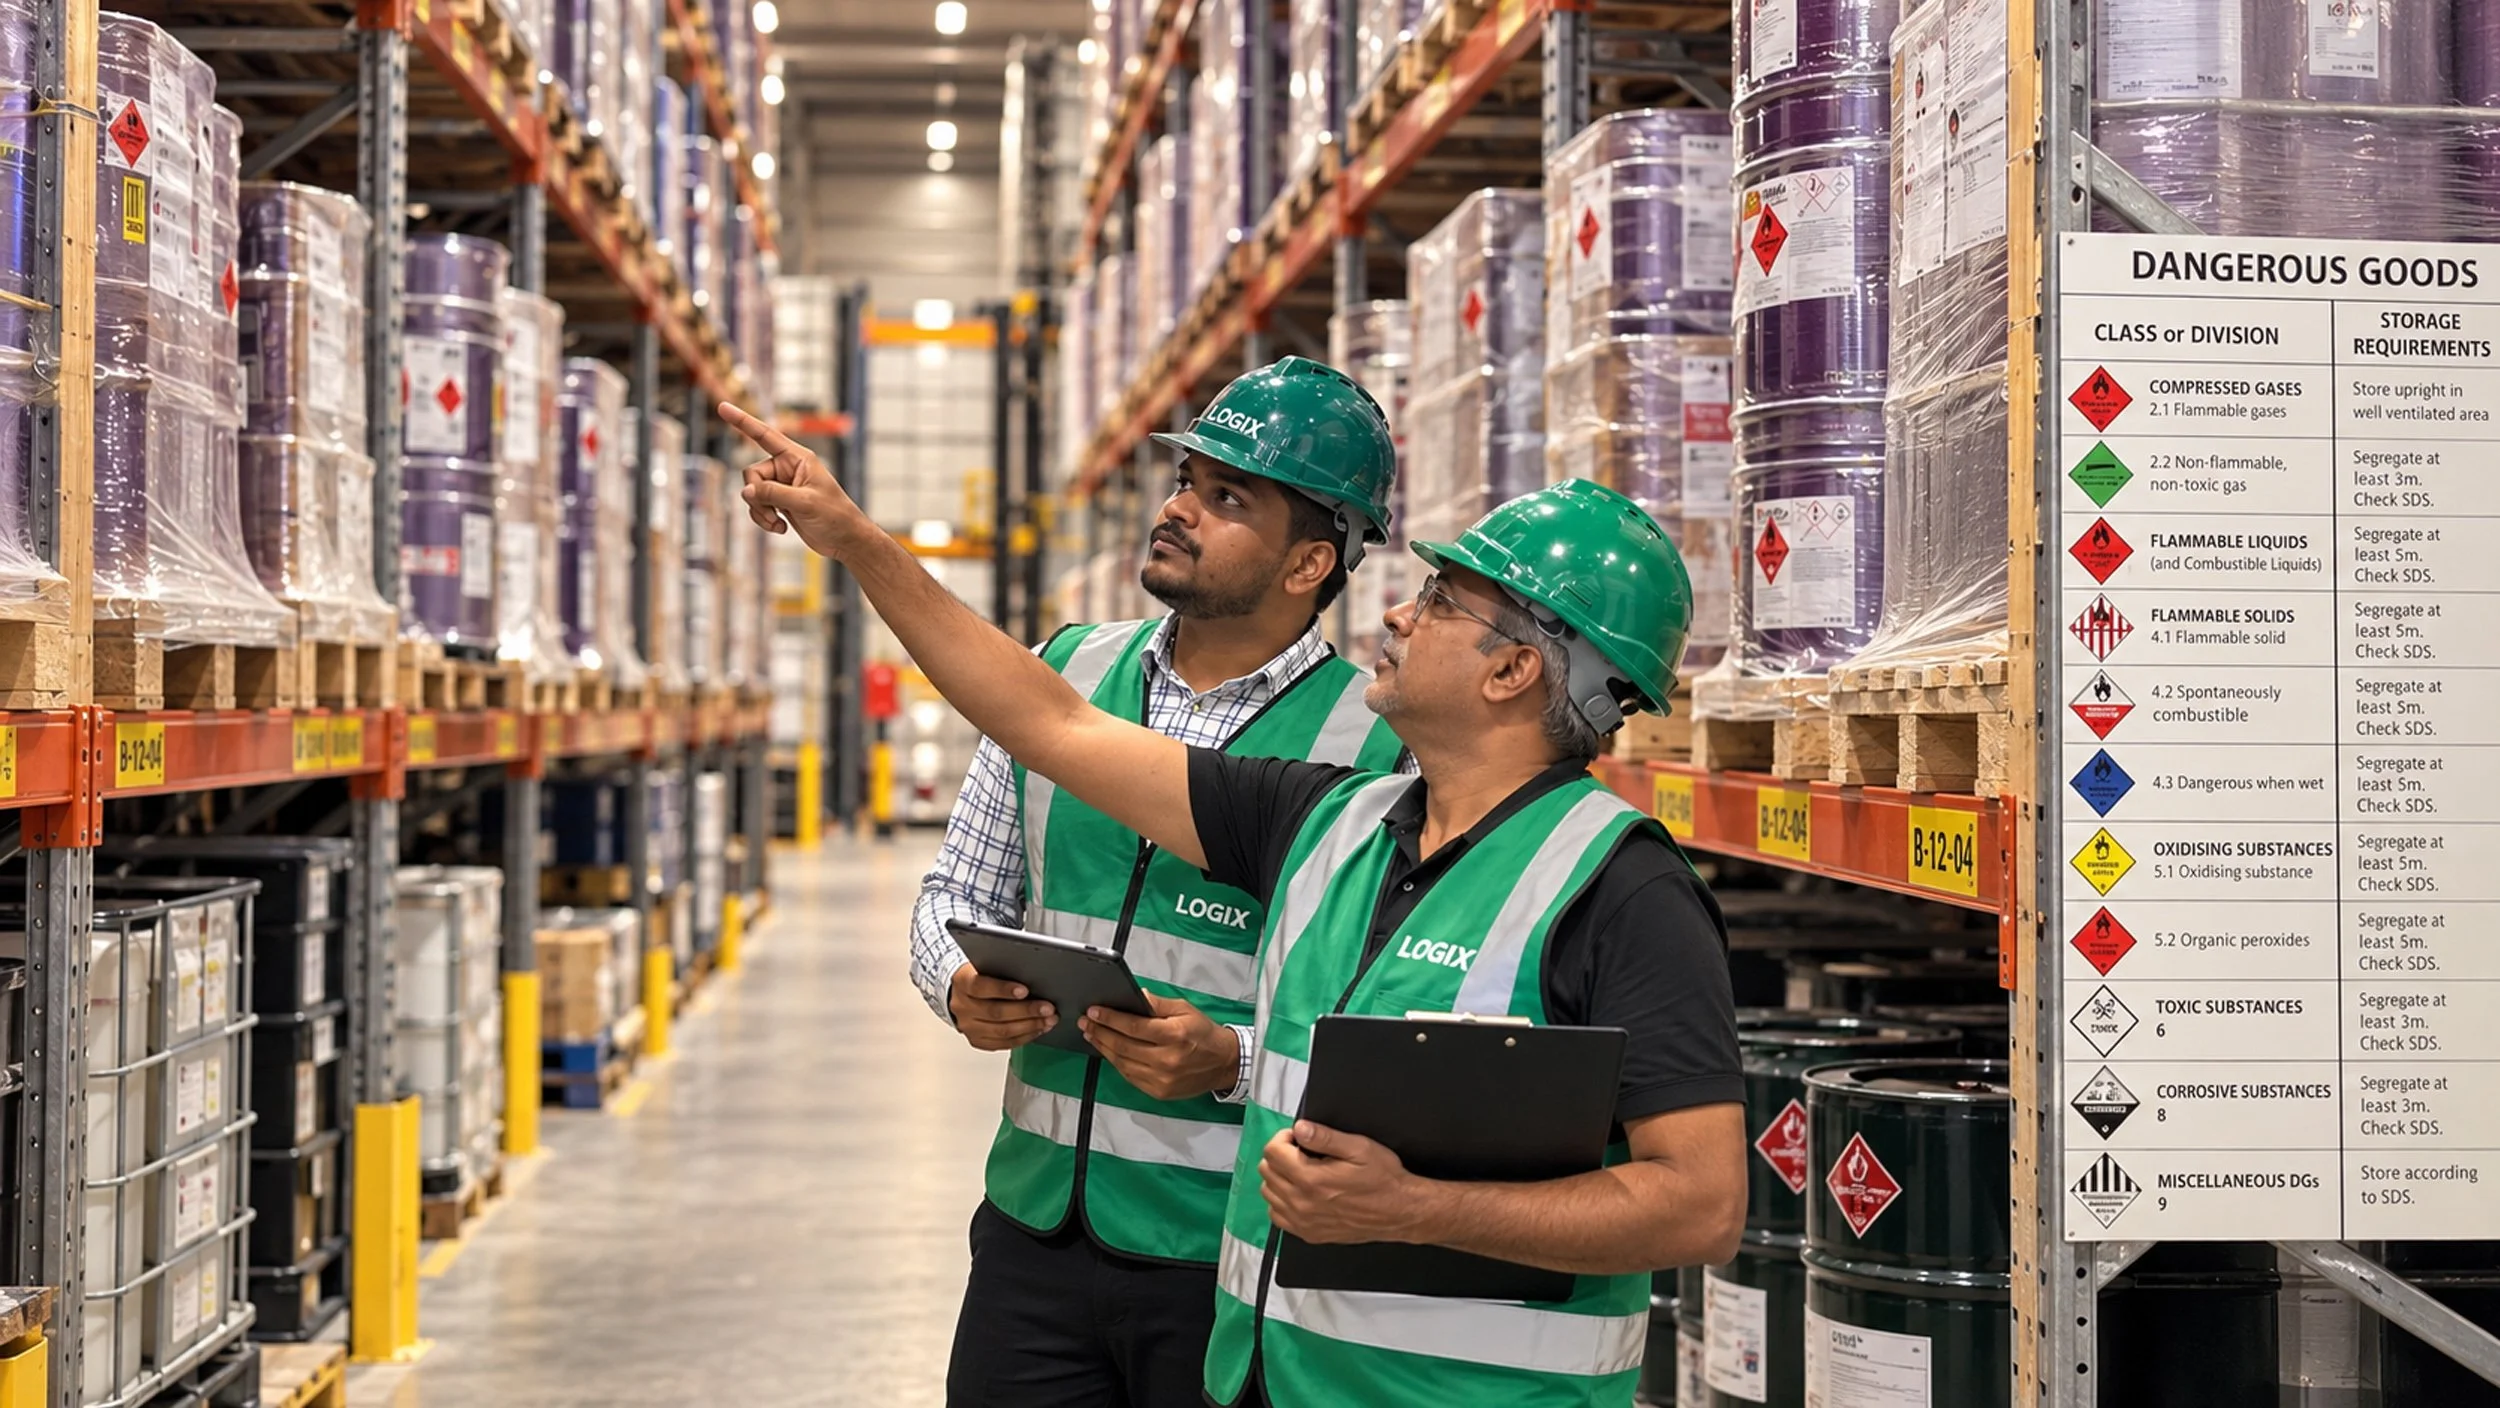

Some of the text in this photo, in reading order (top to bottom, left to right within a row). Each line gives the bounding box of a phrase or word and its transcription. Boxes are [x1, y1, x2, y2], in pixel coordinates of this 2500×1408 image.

[2132, 250, 2479, 289] DANGEROUS GOODS
[2380, 311, 2461, 331] STORAGE
[2094, 323, 2279, 345] CLASS or DIVISION
[2353, 337, 2492, 358] REQUIREMENTS
[2149, 379, 2303, 397] COMPRESSED GASES
[2352, 380, 2463, 401] Store upright in
[2149, 401, 2287, 421] 2.1 Flammable gases
[2352, 404, 2490, 422] well ventilated area
[1206, 404, 1266, 440] LOGIX
[2149, 454, 2288, 472] 2.2 Non-flammable,
[2353, 449, 2441, 469] Segregate at
[2150, 477, 2248, 496] non-toxic gas
[2354, 470, 2423, 487] least 3m.
[2353, 491, 2435, 508] Check SDS.
[2150, 533, 2308, 551] FLAMMABLE LIQUIDS
[2353, 525, 2441, 545] Segregate at
[2354, 546, 2423, 563] least 5m.
[2150, 555, 2322, 574] (and Combustible Liquids)
[2354, 567, 2436, 584] Check SDS.
[2151, 608, 2295, 624] FLAMMABLE SOLIDS
[2354, 601, 2442, 621] Segregate at
[2150, 629, 2286, 645] 4.1 Flammable solid
[2355, 622, 2424, 639] least 5m.
[2355, 642, 2436, 660] Check SDS.
[2151, 684, 2282, 703] 4.2 Spontaneously
[2355, 678, 2443, 697] Segregate at
[2152, 706, 2249, 723] combustible
[2356, 698, 2425, 715] least 5m.
[2355, 720, 2437, 736] Check SDS.
[2356, 755, 2444, 774] Segregate at
[2152, 775, 2325, 794] 4.3 Dangerous when wet
[2357, 776, 2426, 792] least 5m.
[2356, 797, 2438, 814] Check SDS.
[2153, 841, 2334, 857] OXIDISING SUBSTANCES
[2357, 833, 2444, 853] Segregate at
[2358, 855, 2428, 871] least 5m.
[2154, 863, 2314, 883] 5.1 Oxidising substance
[2357, 876, 2439, 892] Check SDS.
[1175, 894, 1251, 930] LOGIX
[2358, 912, 2445, 932] Segregate at
[2154, 932, 2311, 951] 5.2 Organic peroxides
[2359, 933, 2428, 950] least 5m.
[1396, 935, 1479, 972] LOGIX
[2358, 955, 2441, 971] Check SDS.
[2155, 999, 2303, 1015] TOXIC SUBSTANCES
[2359, 991, 2447, 1011] Segregate at
[2156, 1022, 2166, 1038] 6
[2359, 1013, 2429, 1030] least 3m.
[2359, 1034, 2442, 1051] Check SDS.
[2156, 1084, 2332, 1099] CORROSIVE SUBSTANCES
[2360, 1075, 2449, 1094] Segregate at
[2360, 1097, 2431, 1114] least 3m.
[2157, 1107, 2167, 1123] 8
[2360, 1119, 2444, 1136] Check SDS.
[2157, 1173, 2320, 1189] MISCELLANEOUS DGs
[2360, 1164, 2479, 1184] Store according
[2157, 1196, 2168, 1212] 9
[2360, 1188, 2416, 1205] to SDS.
